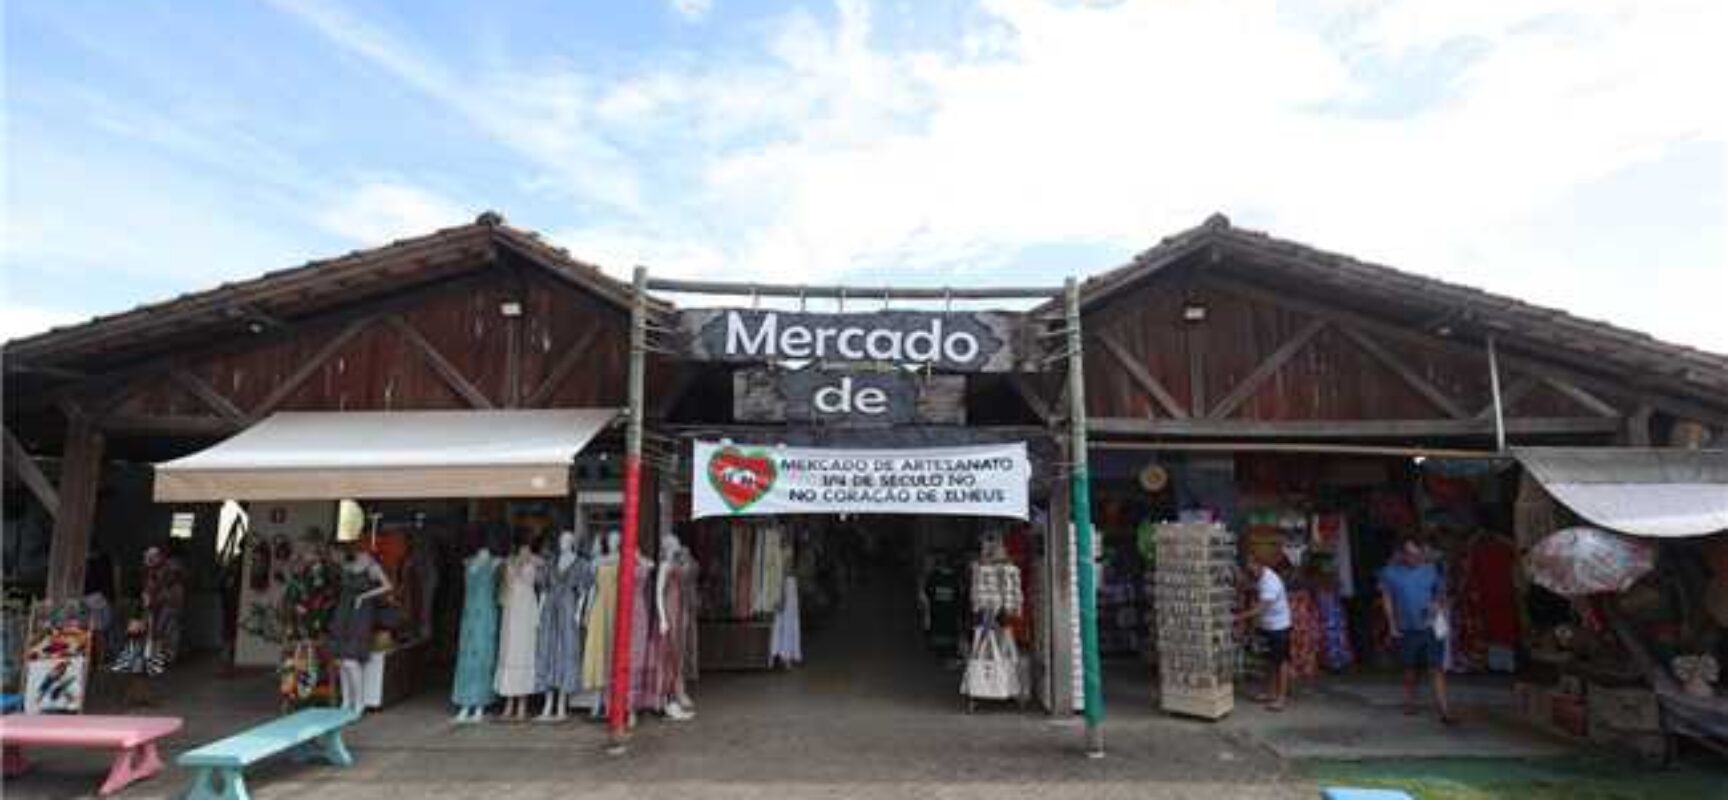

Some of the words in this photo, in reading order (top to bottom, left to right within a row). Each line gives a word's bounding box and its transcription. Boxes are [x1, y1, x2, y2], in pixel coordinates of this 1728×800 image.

[725, 311, 979, 362] Mercado
[814, 377, 887, 412] de
[781, 459, 868, 471] MERCADO
[874, 459, 894, 471] DE
[901, 457, 1013, 471] ARTESANATO
[853, 475, 873, 487] DE
[949, 474, 976, 487] NO
[789, 489, 816, 502] NO
[917, 489, 937, 502] DE
